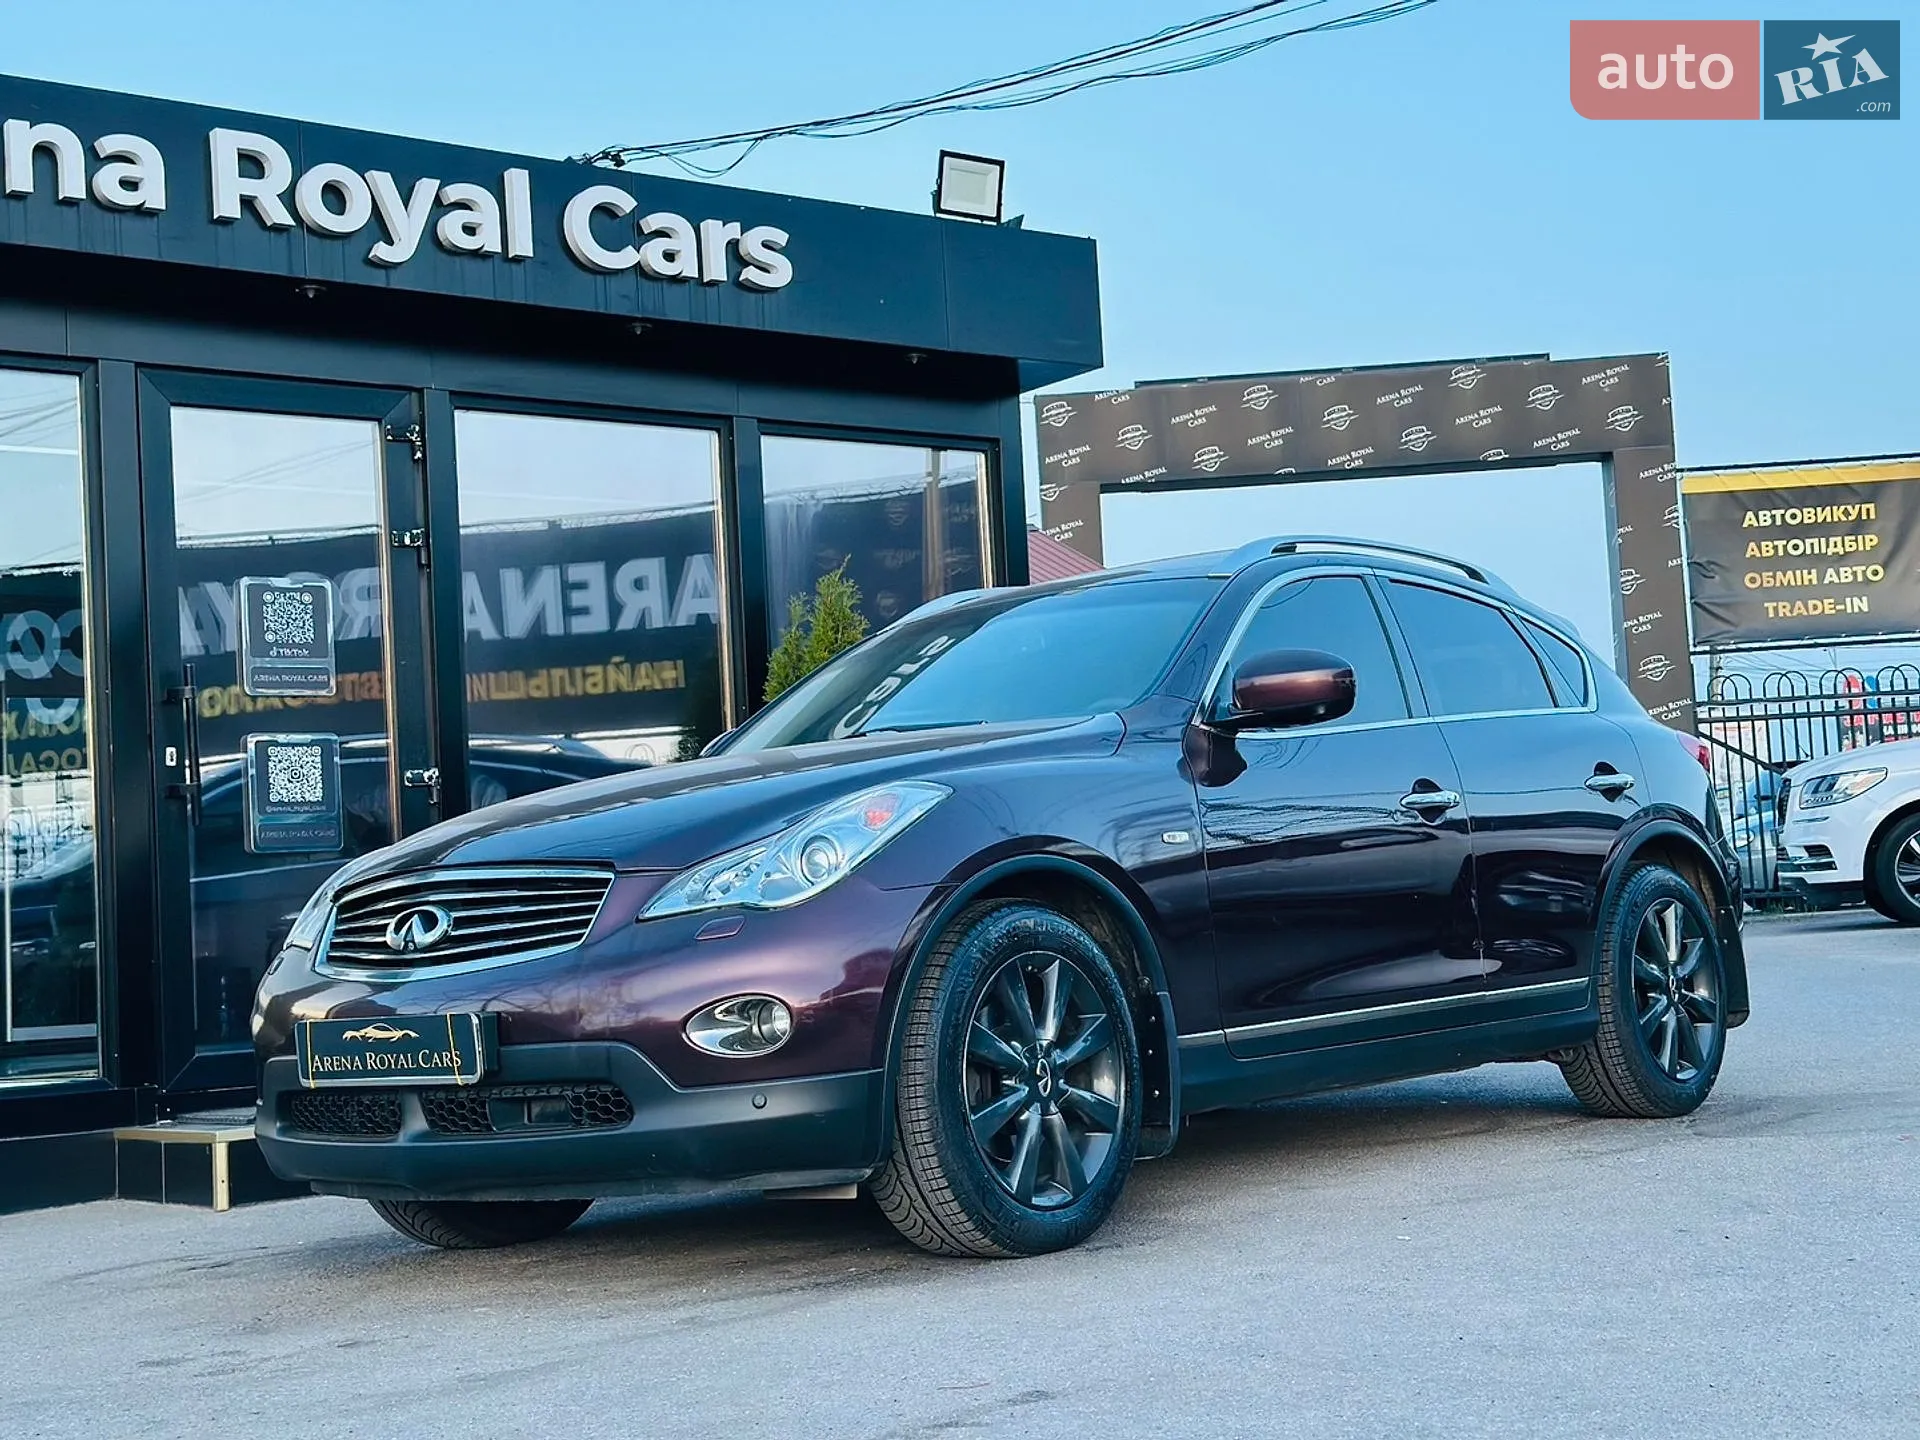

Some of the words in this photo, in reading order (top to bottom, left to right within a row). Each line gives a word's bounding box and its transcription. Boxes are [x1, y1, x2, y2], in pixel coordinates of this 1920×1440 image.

[208, 127, 533, 267] Royal
[563, 185, 794, 290] Cars
[1742, 503, 1876, 528] АВТОВИКУП
[1745, 534, 1879, 558] АВТОПІДБІР
[1744, 568, 1817, 589] ОБМІН
[1823, 564, 1885, 584] АВТО
[1764, 596, 1869, 618] TRADE-IN
